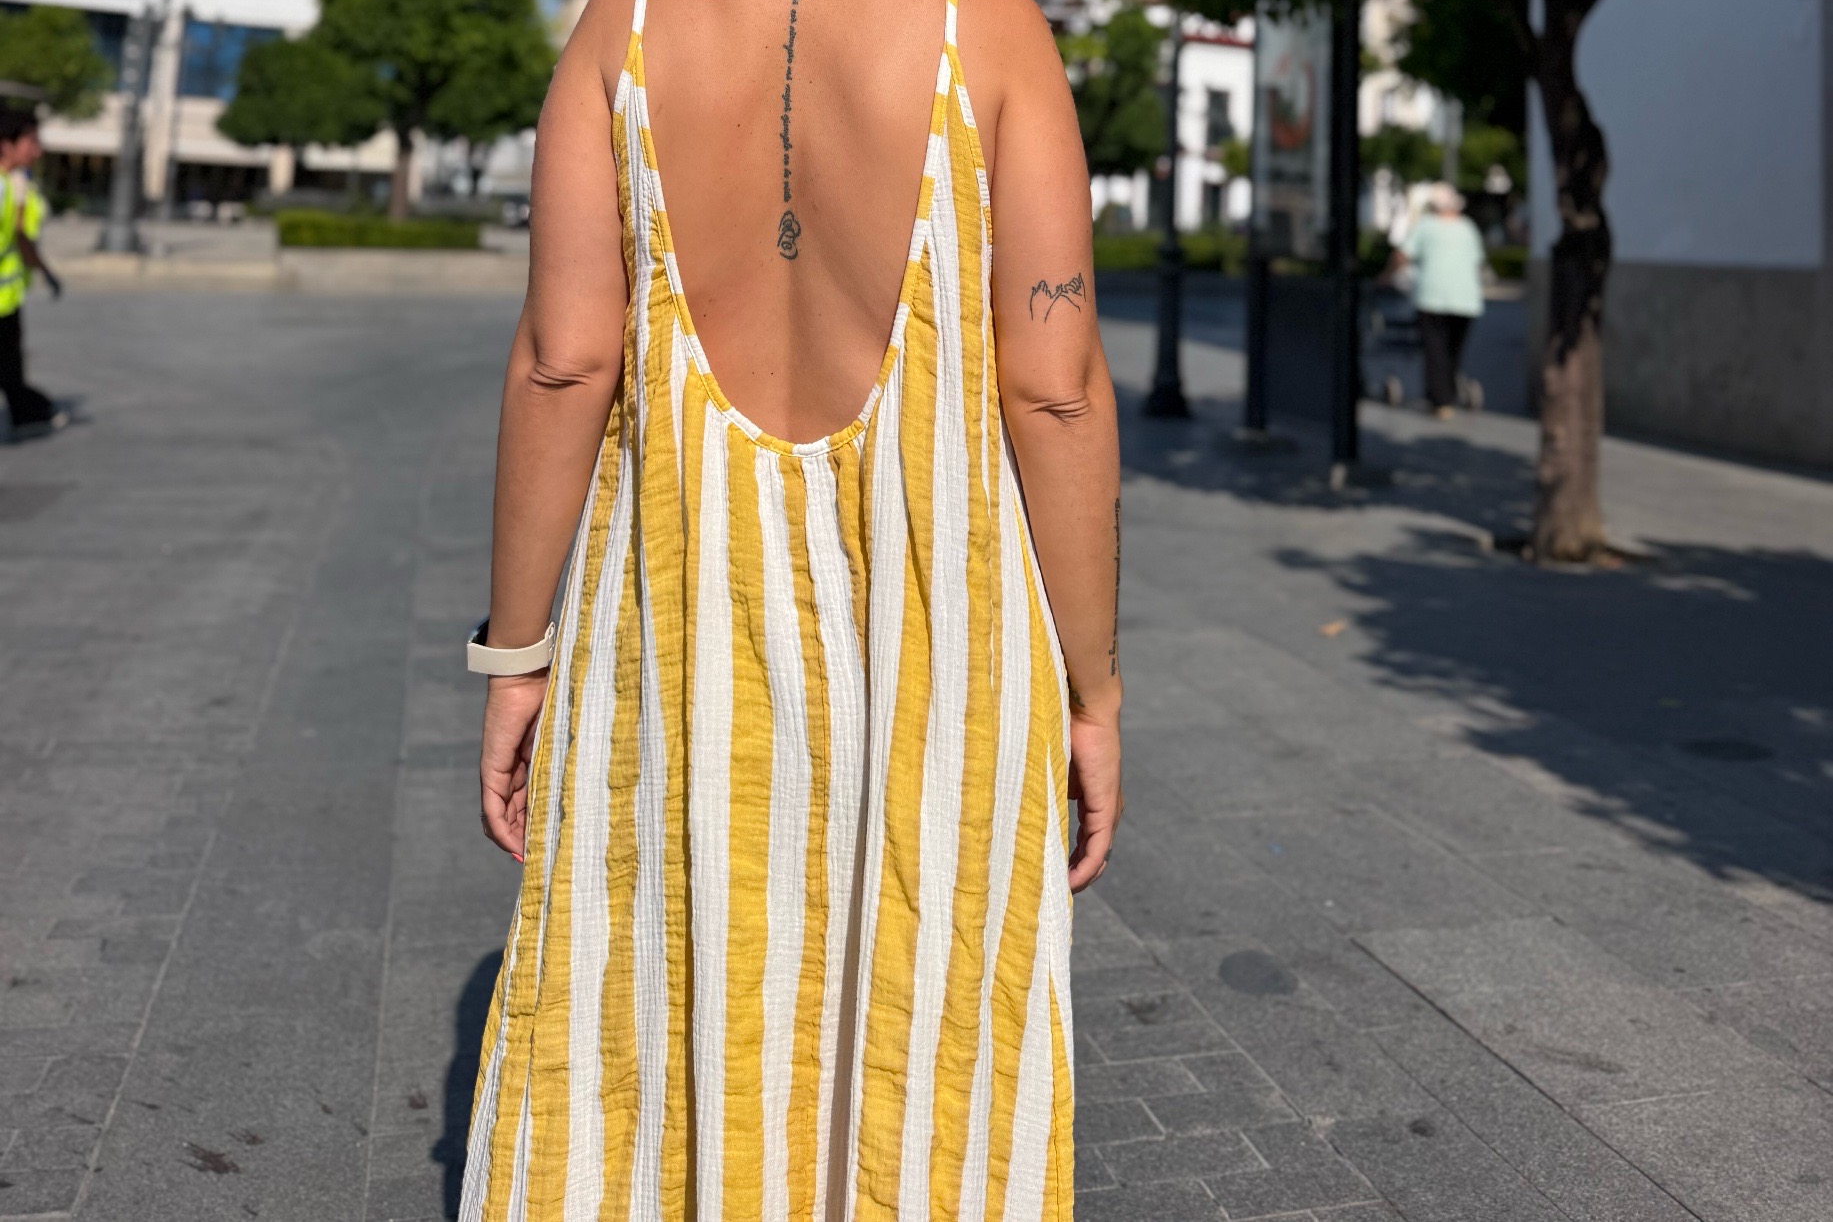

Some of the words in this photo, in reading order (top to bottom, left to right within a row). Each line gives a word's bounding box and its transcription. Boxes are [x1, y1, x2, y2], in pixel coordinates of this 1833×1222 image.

[782, 25, 797, 64] siempre
[785, 65, 793, 81] mi
[781, 83, 792, 112] mejor
[780, 113, 793, 151] ejemplo
[783, 153, 790, 166] en
[783, 167, 792, 178] la
[783, 180, 792, 203] vida
